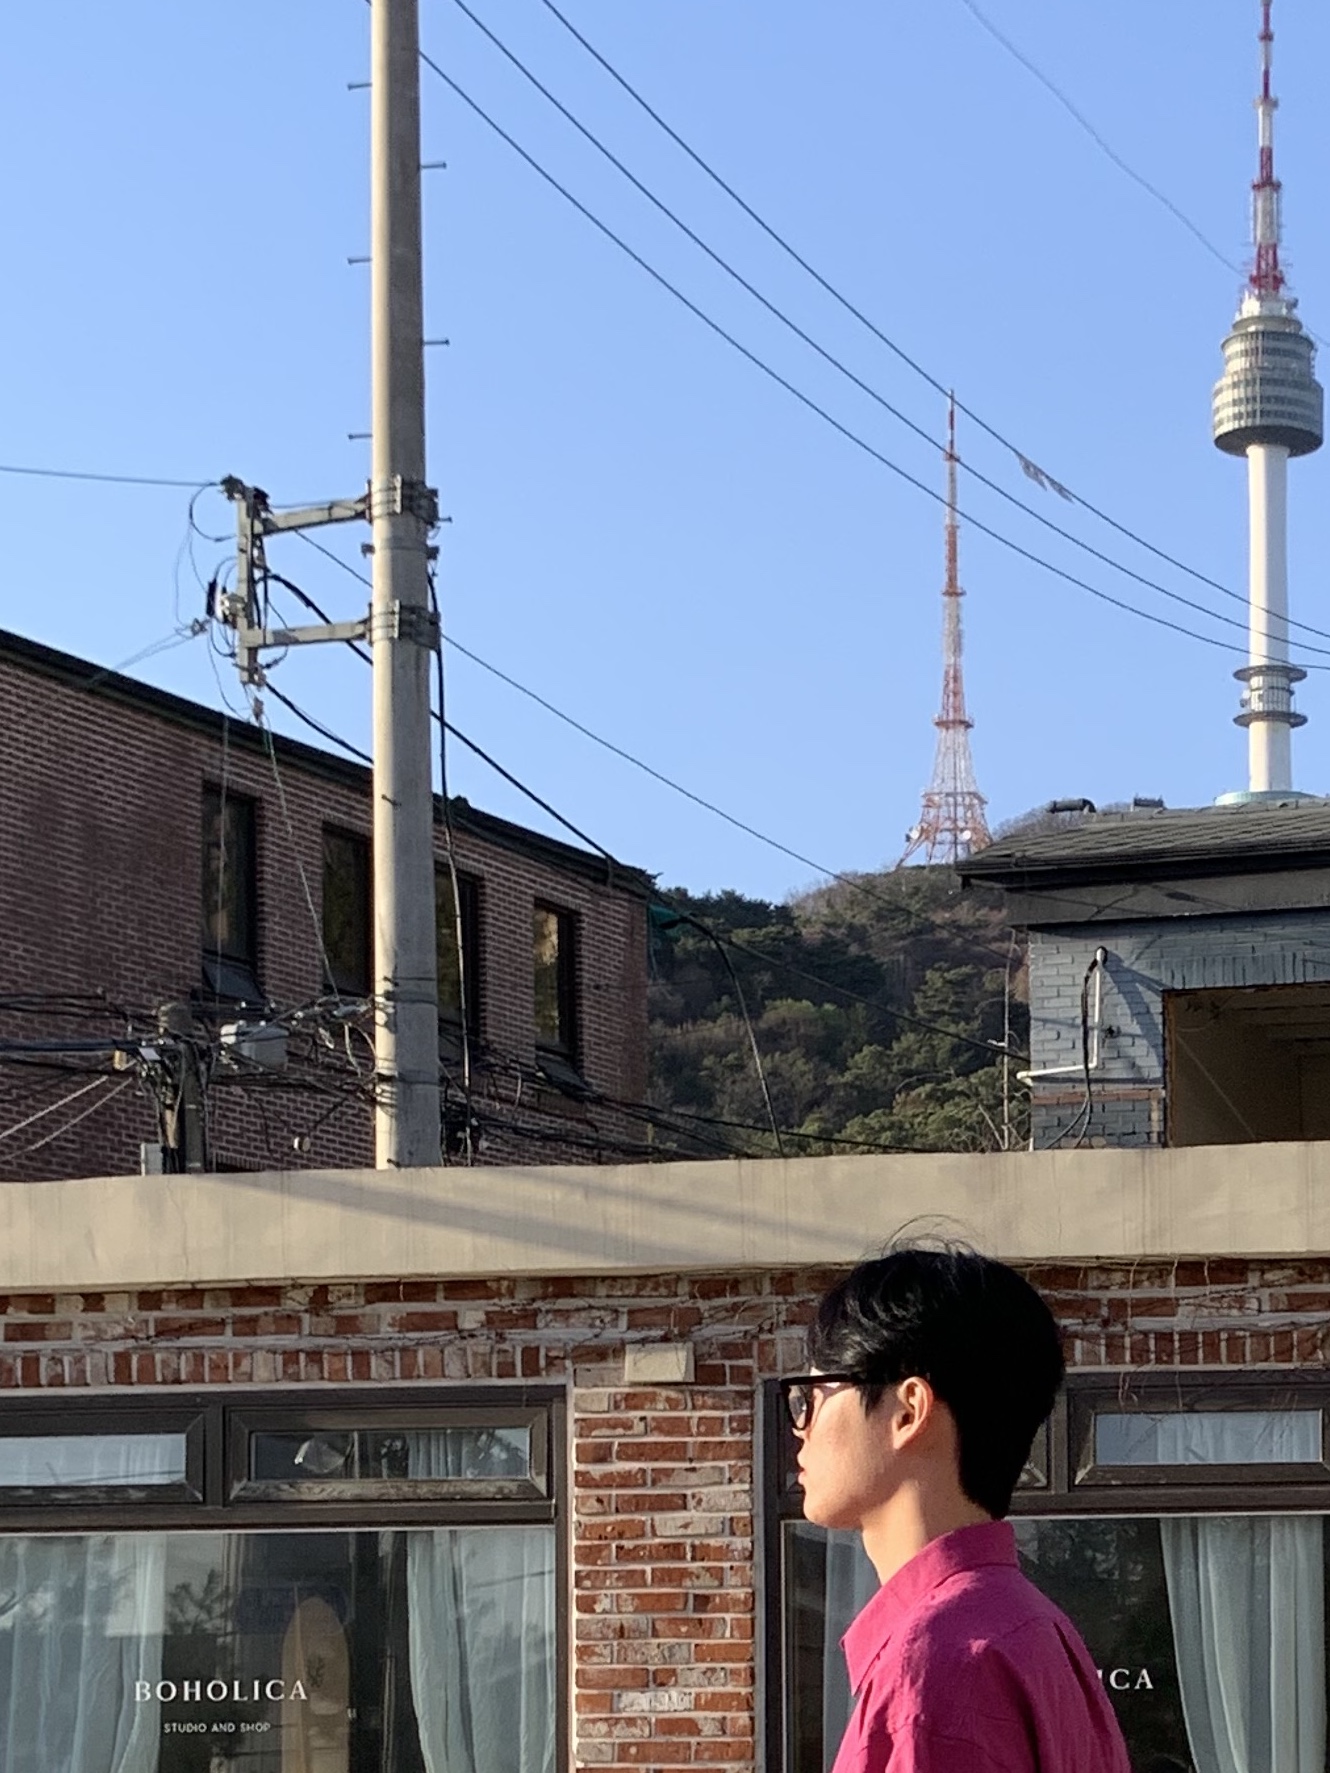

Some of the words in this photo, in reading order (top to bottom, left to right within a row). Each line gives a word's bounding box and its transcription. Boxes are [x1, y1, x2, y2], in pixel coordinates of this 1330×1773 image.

[134, 1679, 308, 1702] BOHOLICA
[164, 1722, 208, 1734] STUDIO
[211, 1722, 236, 1733] AND
[240, 1721, 271, 1732] SHOP
